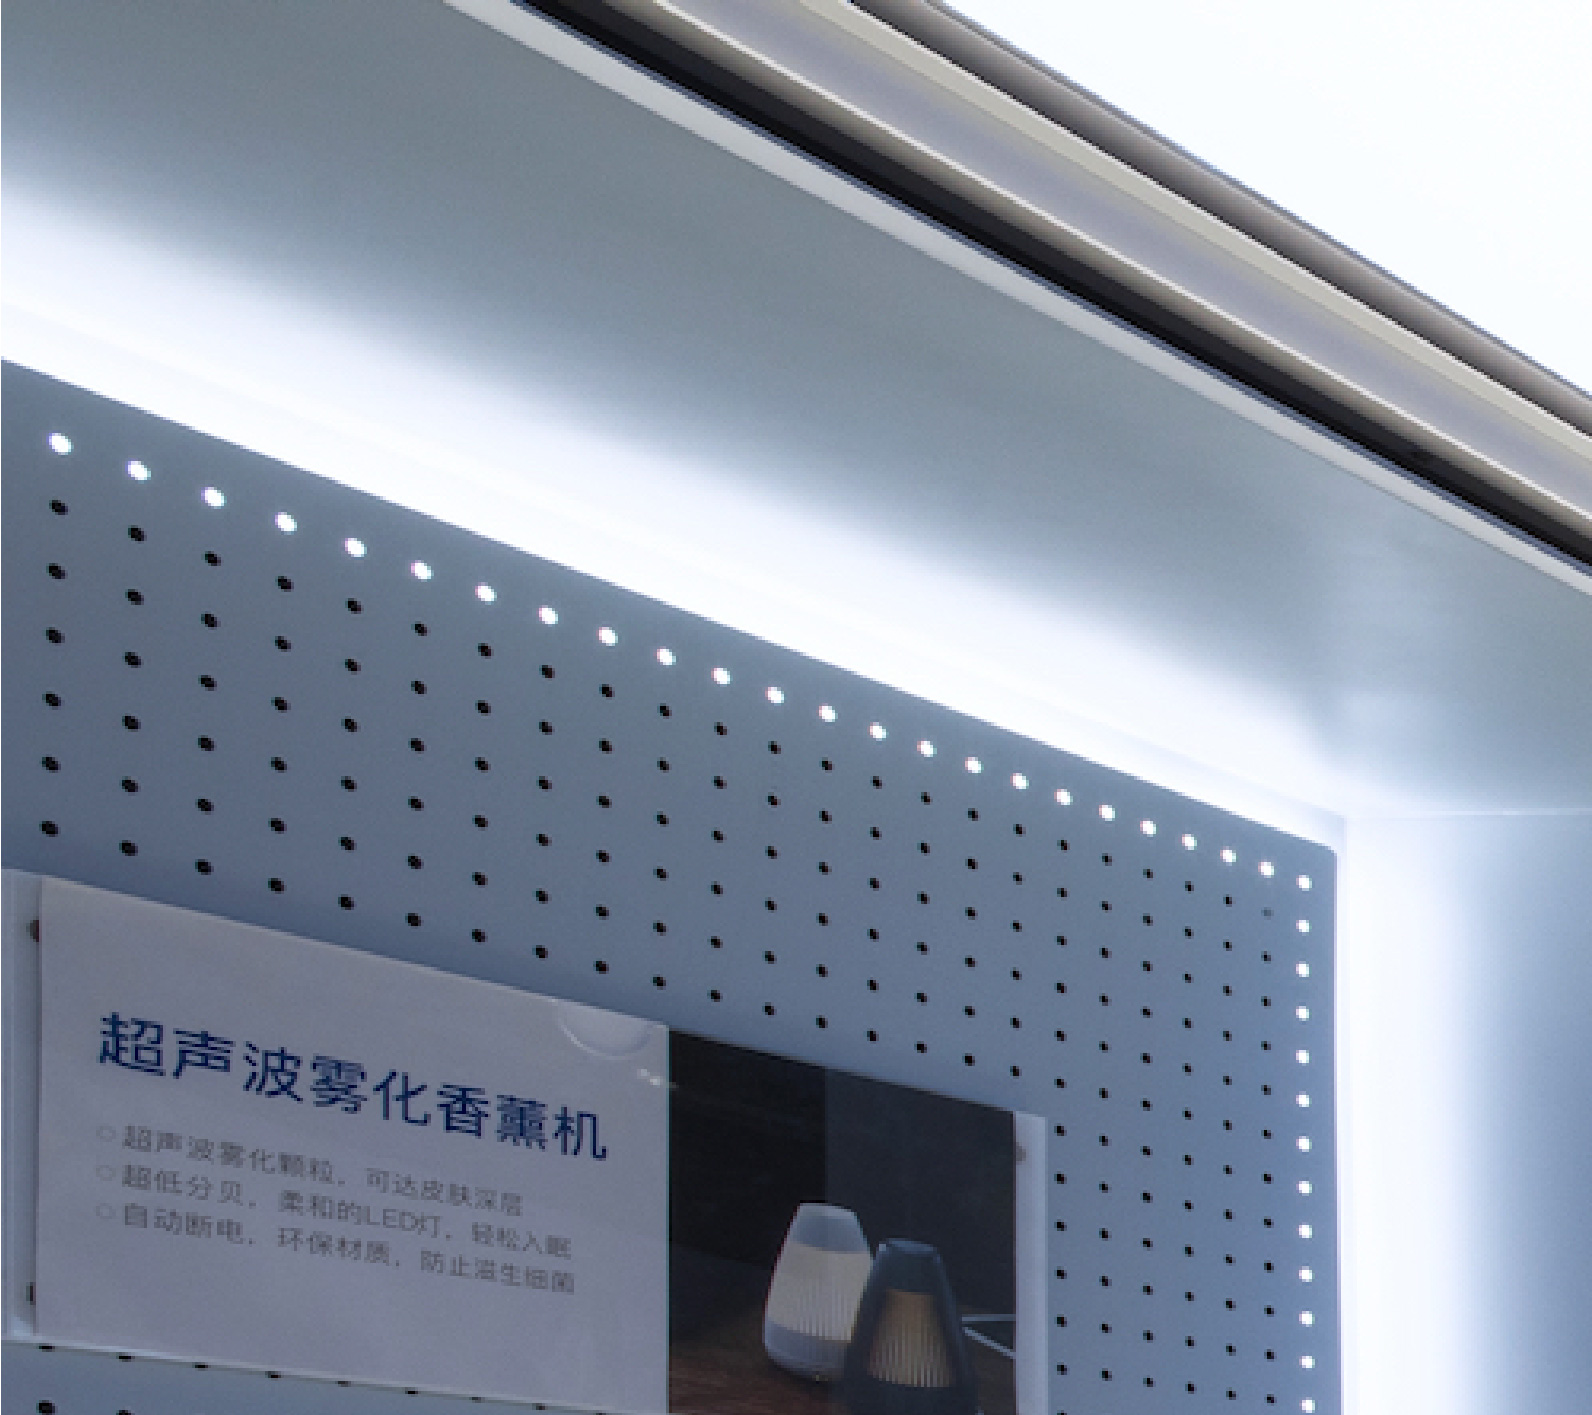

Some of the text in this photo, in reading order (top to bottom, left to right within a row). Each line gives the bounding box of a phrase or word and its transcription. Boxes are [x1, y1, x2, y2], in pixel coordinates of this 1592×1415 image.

[99, 1011, 609, 1161] 超声波雾化香薰机
